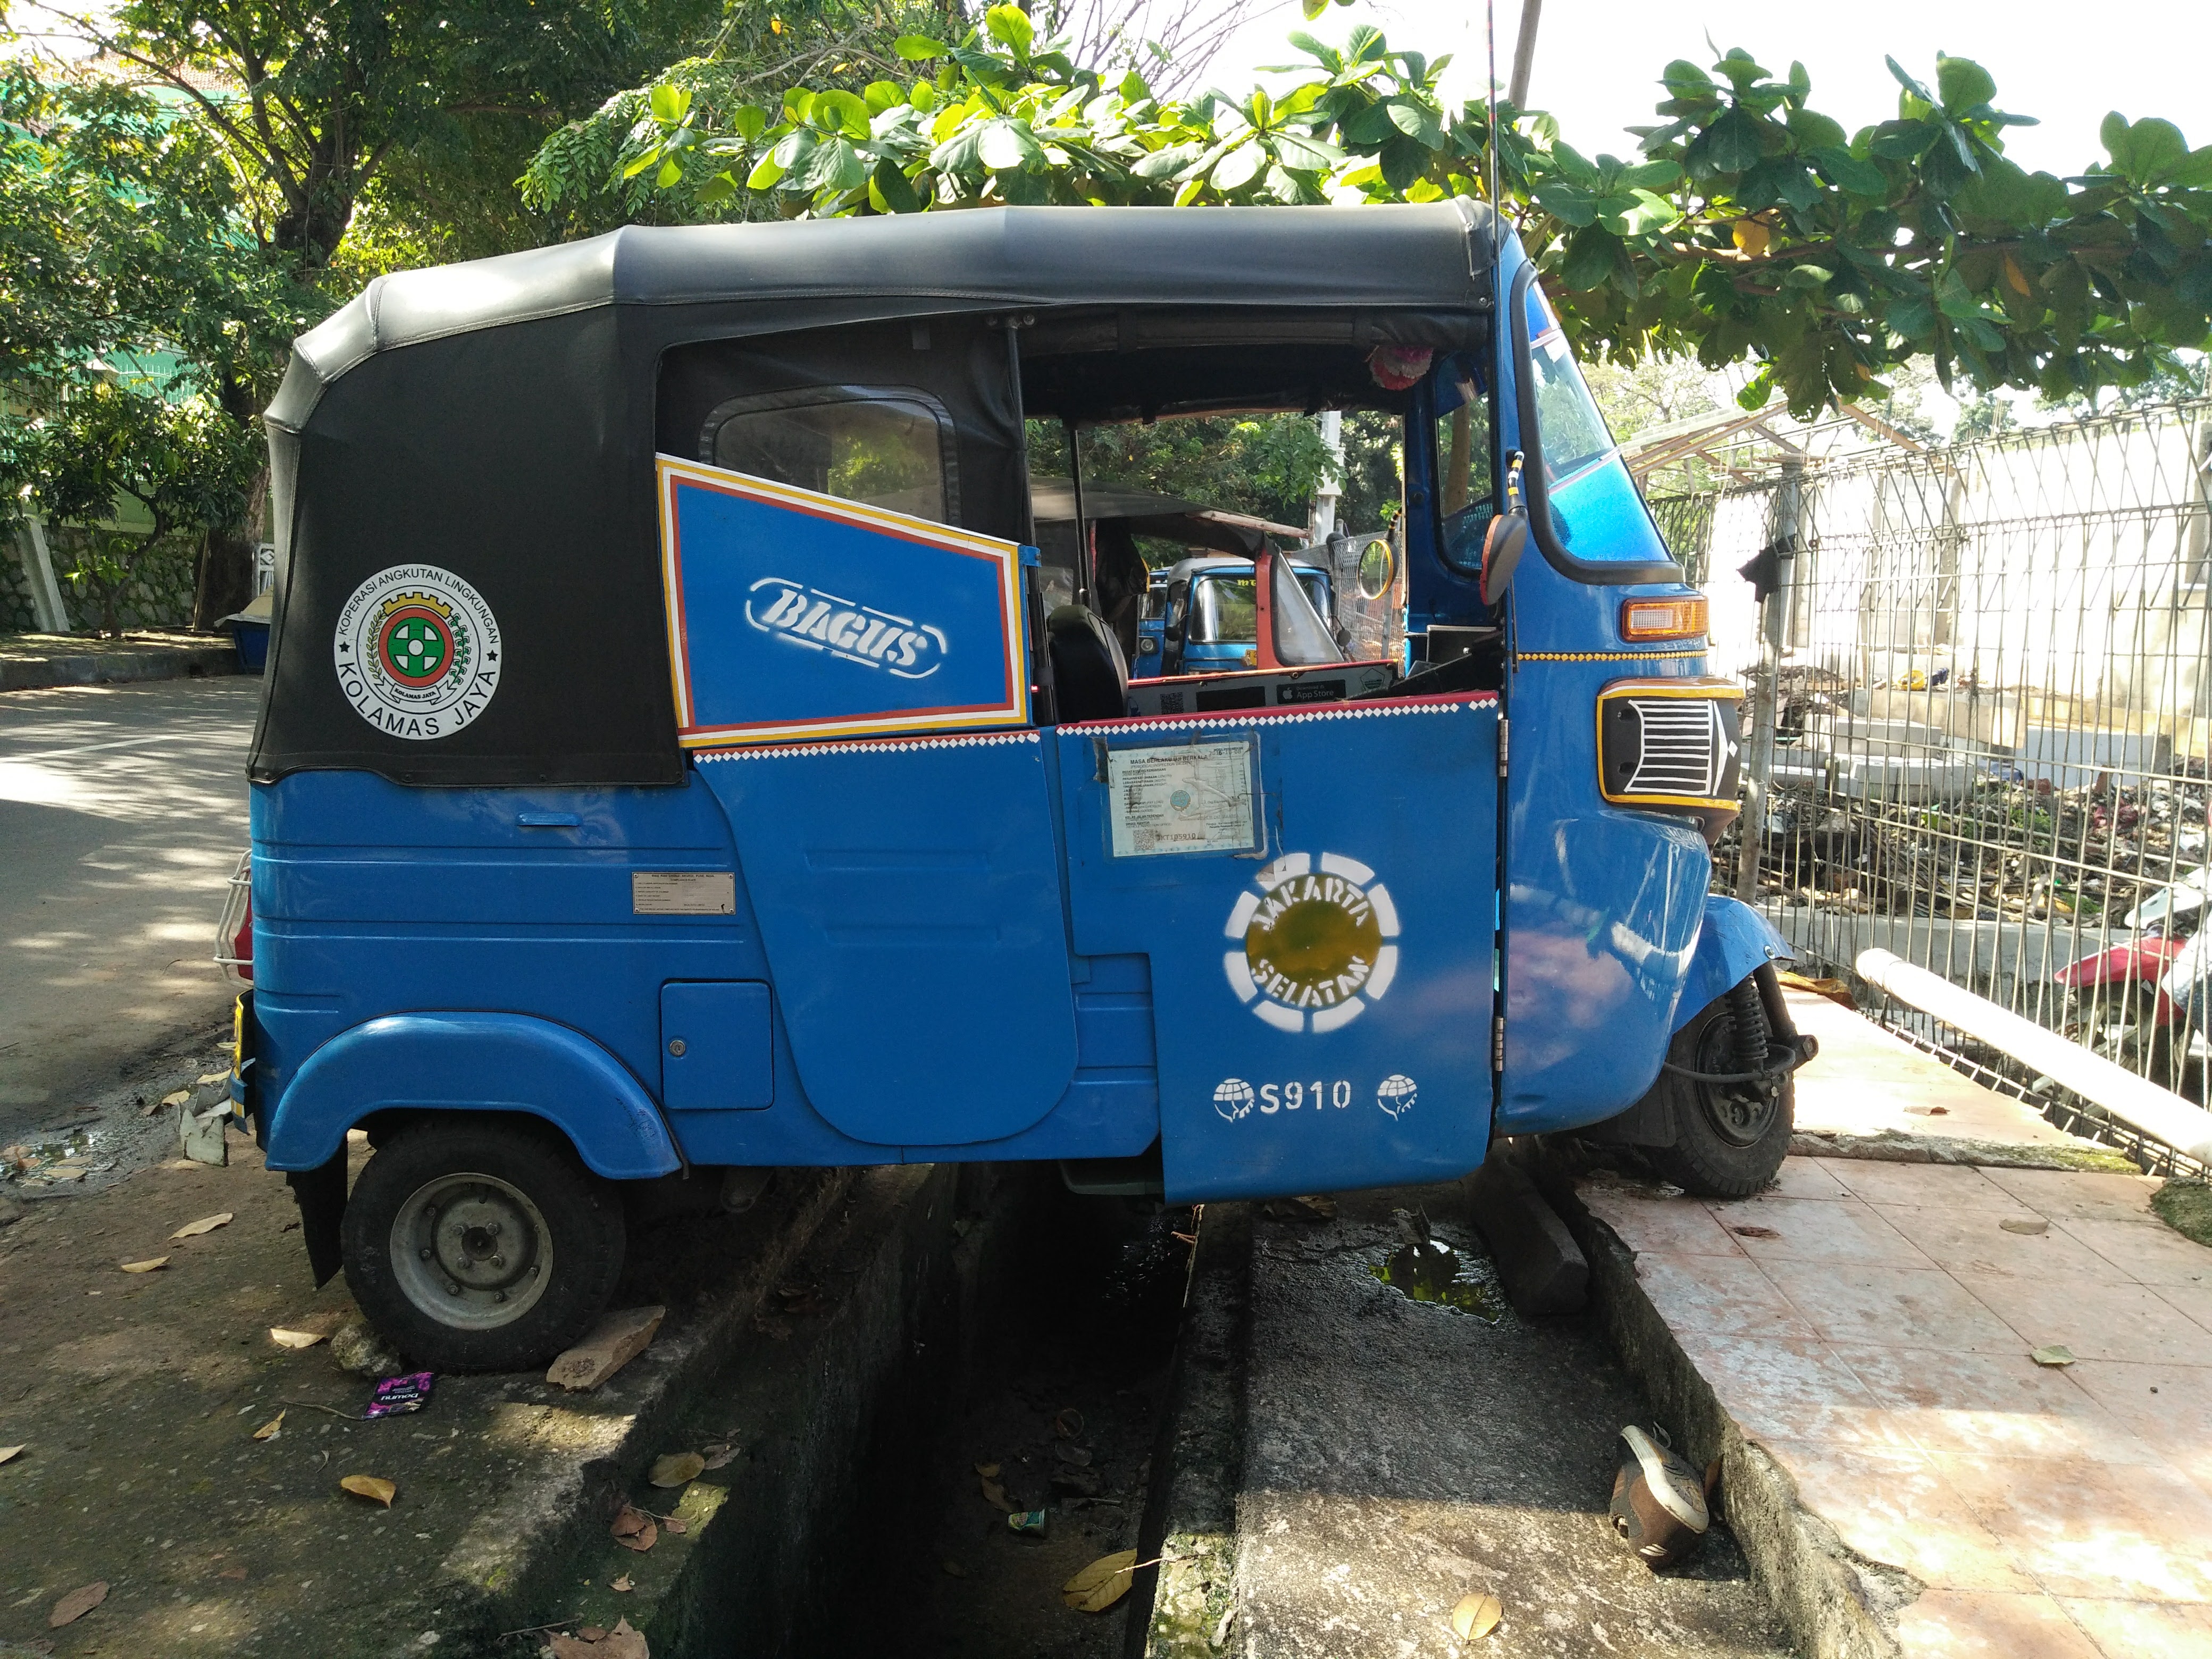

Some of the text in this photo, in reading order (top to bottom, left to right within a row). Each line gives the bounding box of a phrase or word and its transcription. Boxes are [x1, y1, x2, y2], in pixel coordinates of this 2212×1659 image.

[338, 567, 499, 644] KOPERASI ANGKUTAN LINGKUNGAN
[761, 589, 927, 666] BAGUS
[338, 661, 496, 736] KOLAMAS JAYA
[394, 688, 436, 699] KOLAMAS JAYA
[1297, 691, 1312, 700] App
[1251, 875, 1370, 933] JAKARTA
[1251, 955, 1370, 1008] SELATAN
[1260, 1079, 1351, 1113] S910
